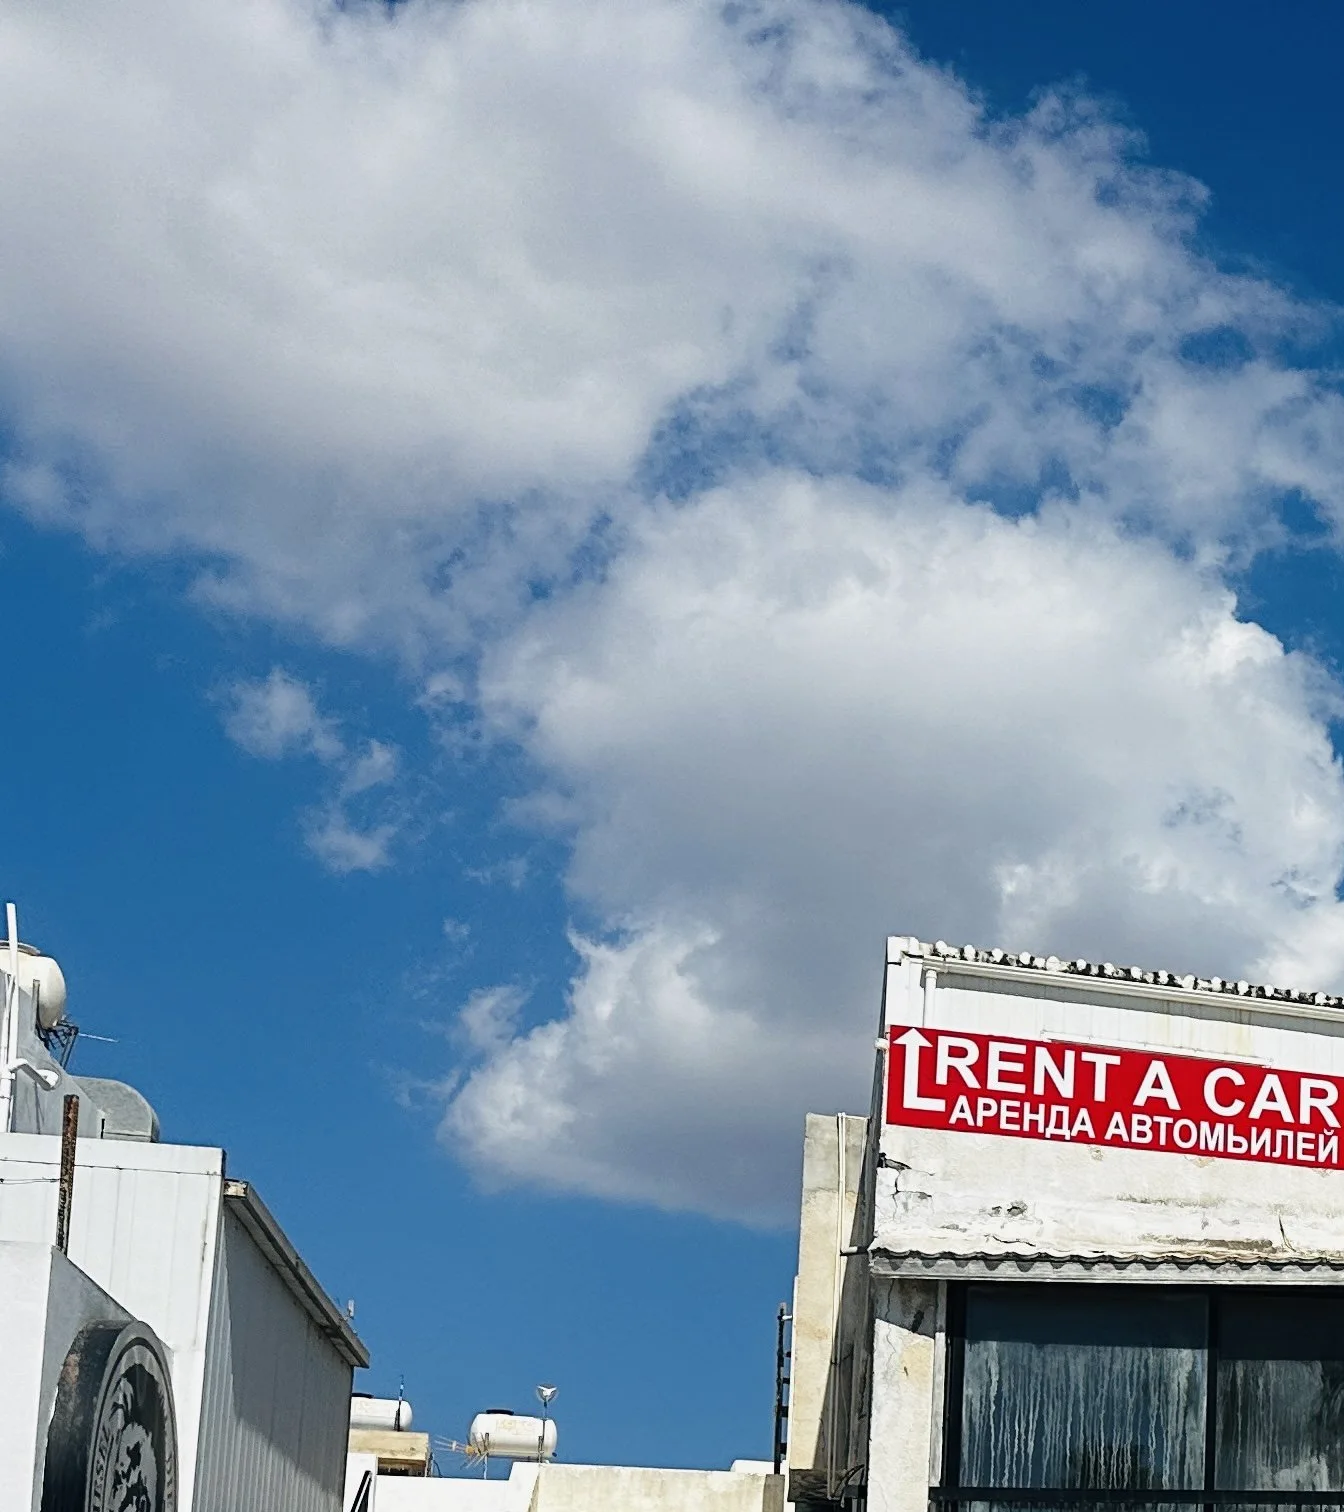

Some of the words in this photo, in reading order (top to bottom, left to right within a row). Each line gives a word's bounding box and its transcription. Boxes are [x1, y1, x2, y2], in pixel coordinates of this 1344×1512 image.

[936, 1035, 1120, 1103] RENT
[1132, 1060, 1181, 1111] A
[1202, 1066, 1341, 1129] CAR
[949, 1094, 1096, 1142] АРЕНДА
[1104, 1111, 1339, 1166] АВТОМЬИЛЕЙ
